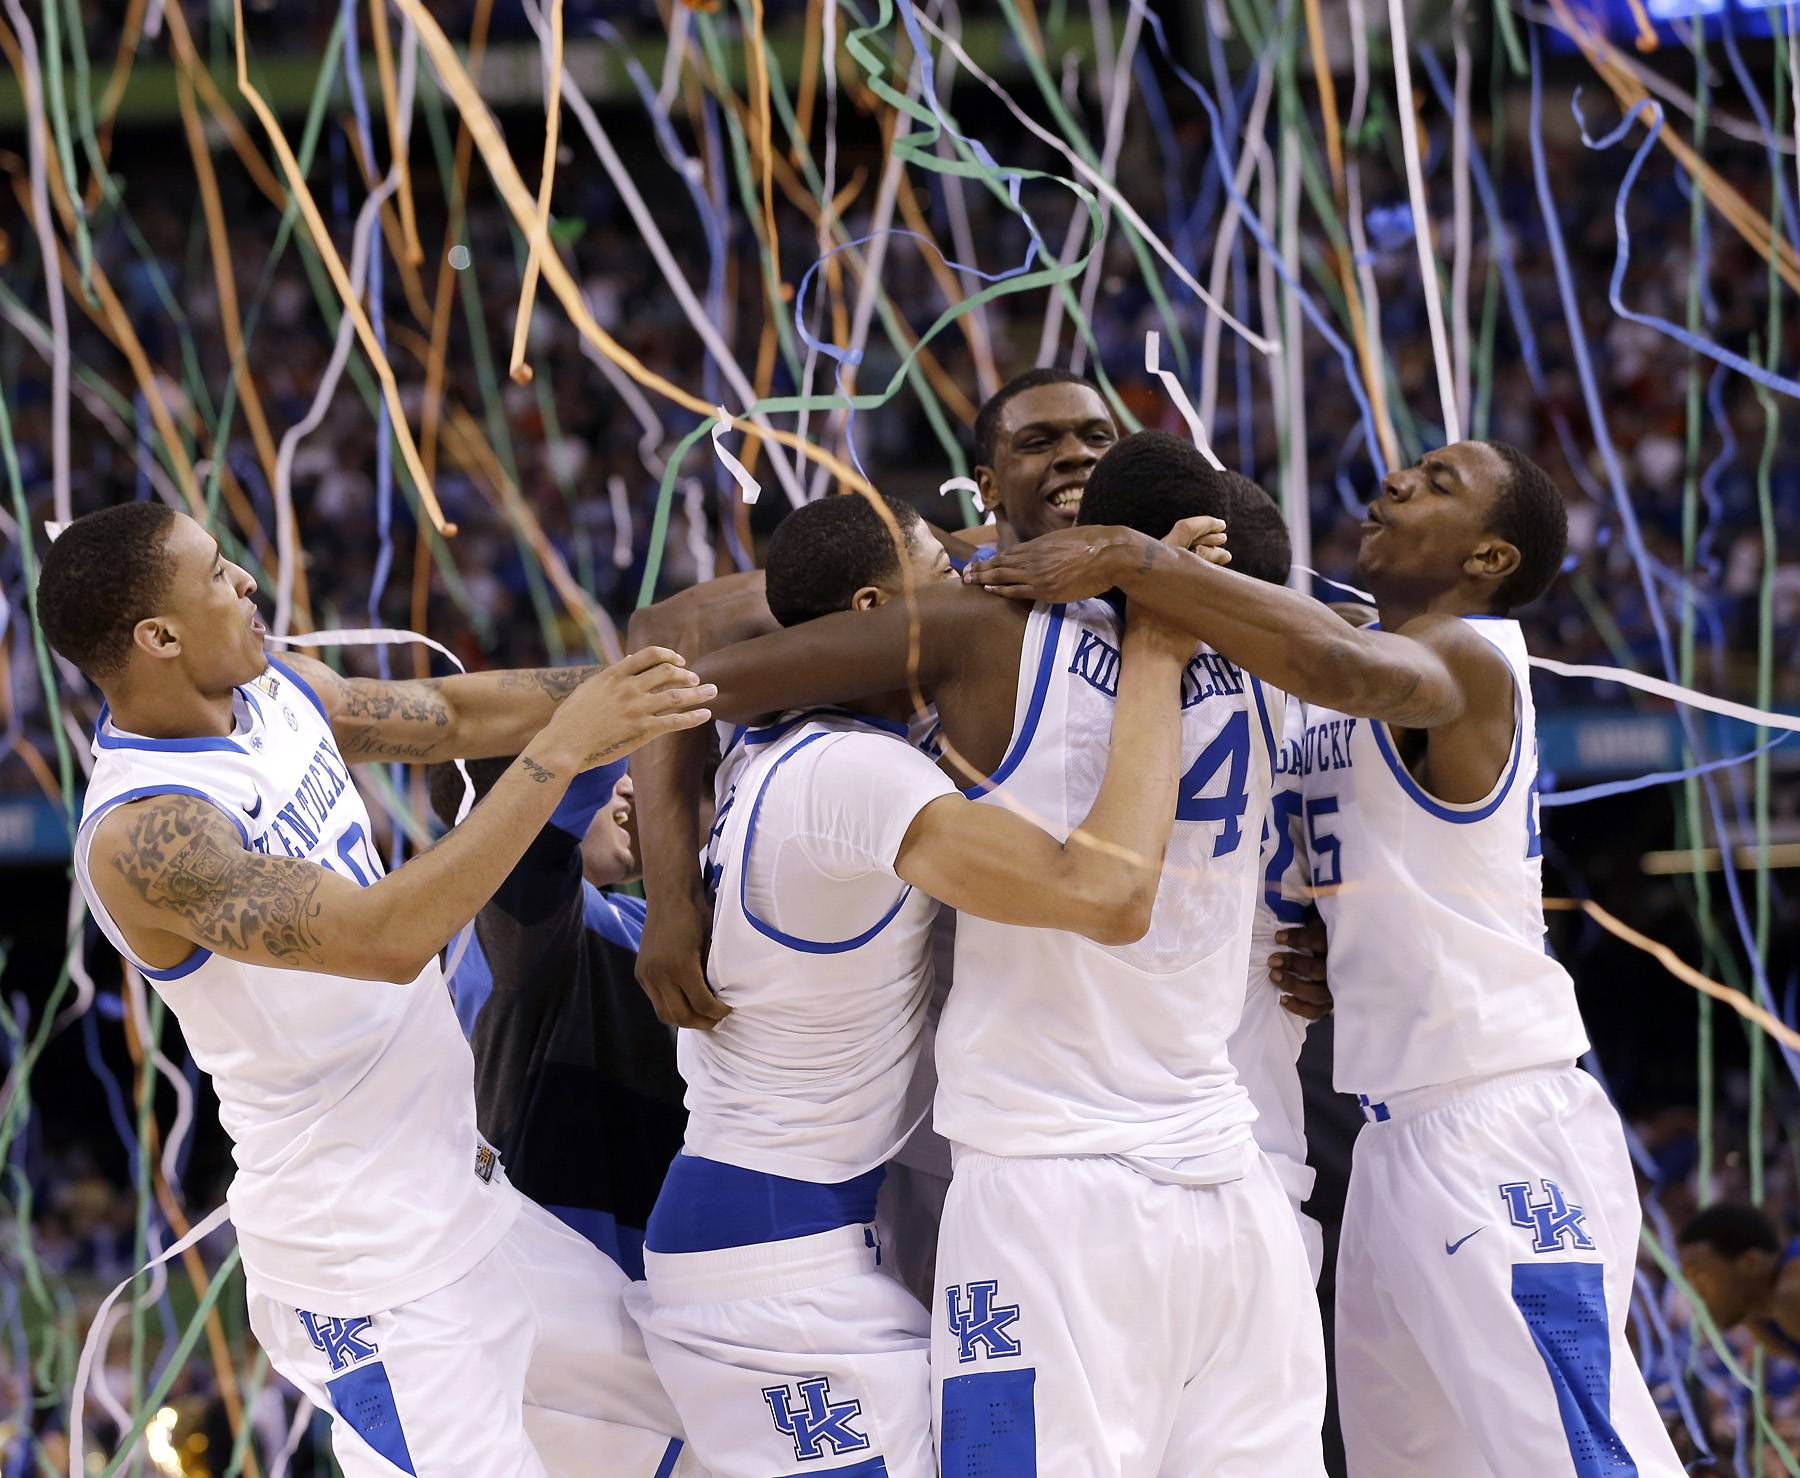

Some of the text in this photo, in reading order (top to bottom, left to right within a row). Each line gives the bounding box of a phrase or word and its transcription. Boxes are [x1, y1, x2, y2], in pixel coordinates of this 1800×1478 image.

[1175, 710, 1250, 858] 4
[1499, 1178, 1596, 1253] UK
[945, 1279, 1021, 1363] UK
[761, 1377, 870, 1461] UK
